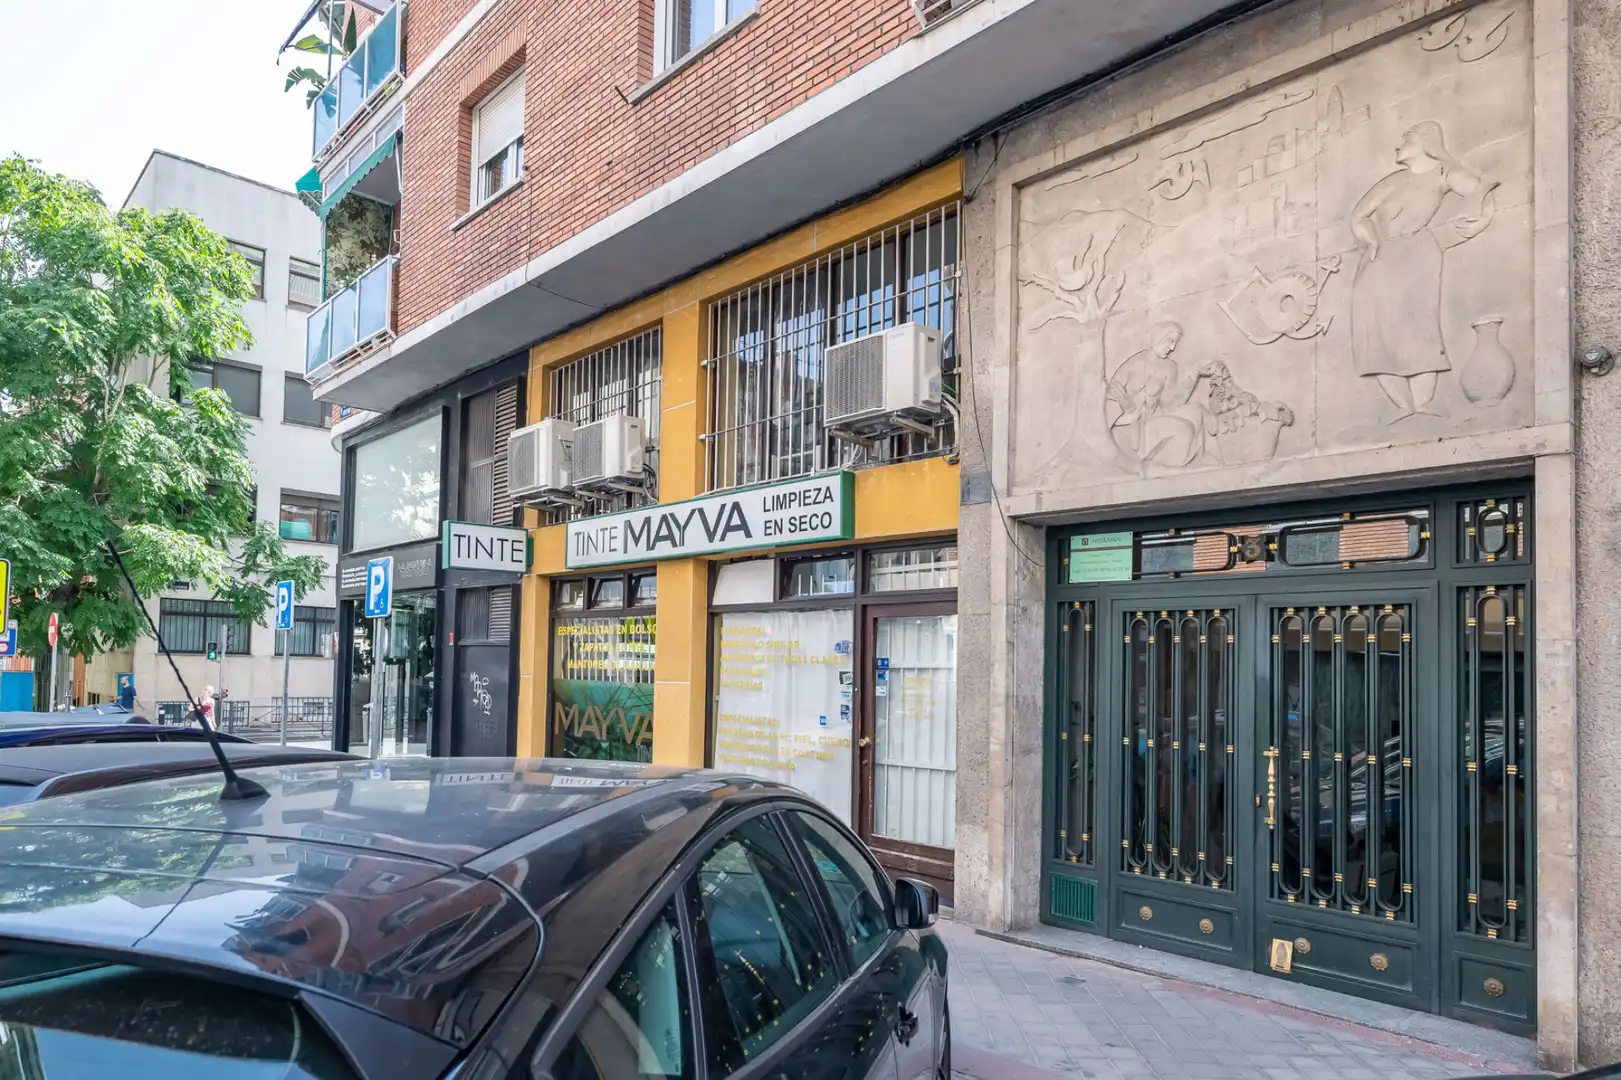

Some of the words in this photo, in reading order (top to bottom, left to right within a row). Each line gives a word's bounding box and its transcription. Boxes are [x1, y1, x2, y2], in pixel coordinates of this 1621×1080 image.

[763, 486, 834, 513] LIMPIEZA
[574, 526, 618, 556] TINTE
[623, 501, 753, 554] MAYVA
[764, 518, 783, 536] EN
[788, 512, 832, 533] SECO
[453, 533, 523, 563] TINTE
[369, 565, 385, 610] P
[278, 587, 288, 623] P
[558, 624, 613, 635] ESPECIALISTAS
[616, 624, 627, 634] EN
[818, 737, 850, 748] CUERO
